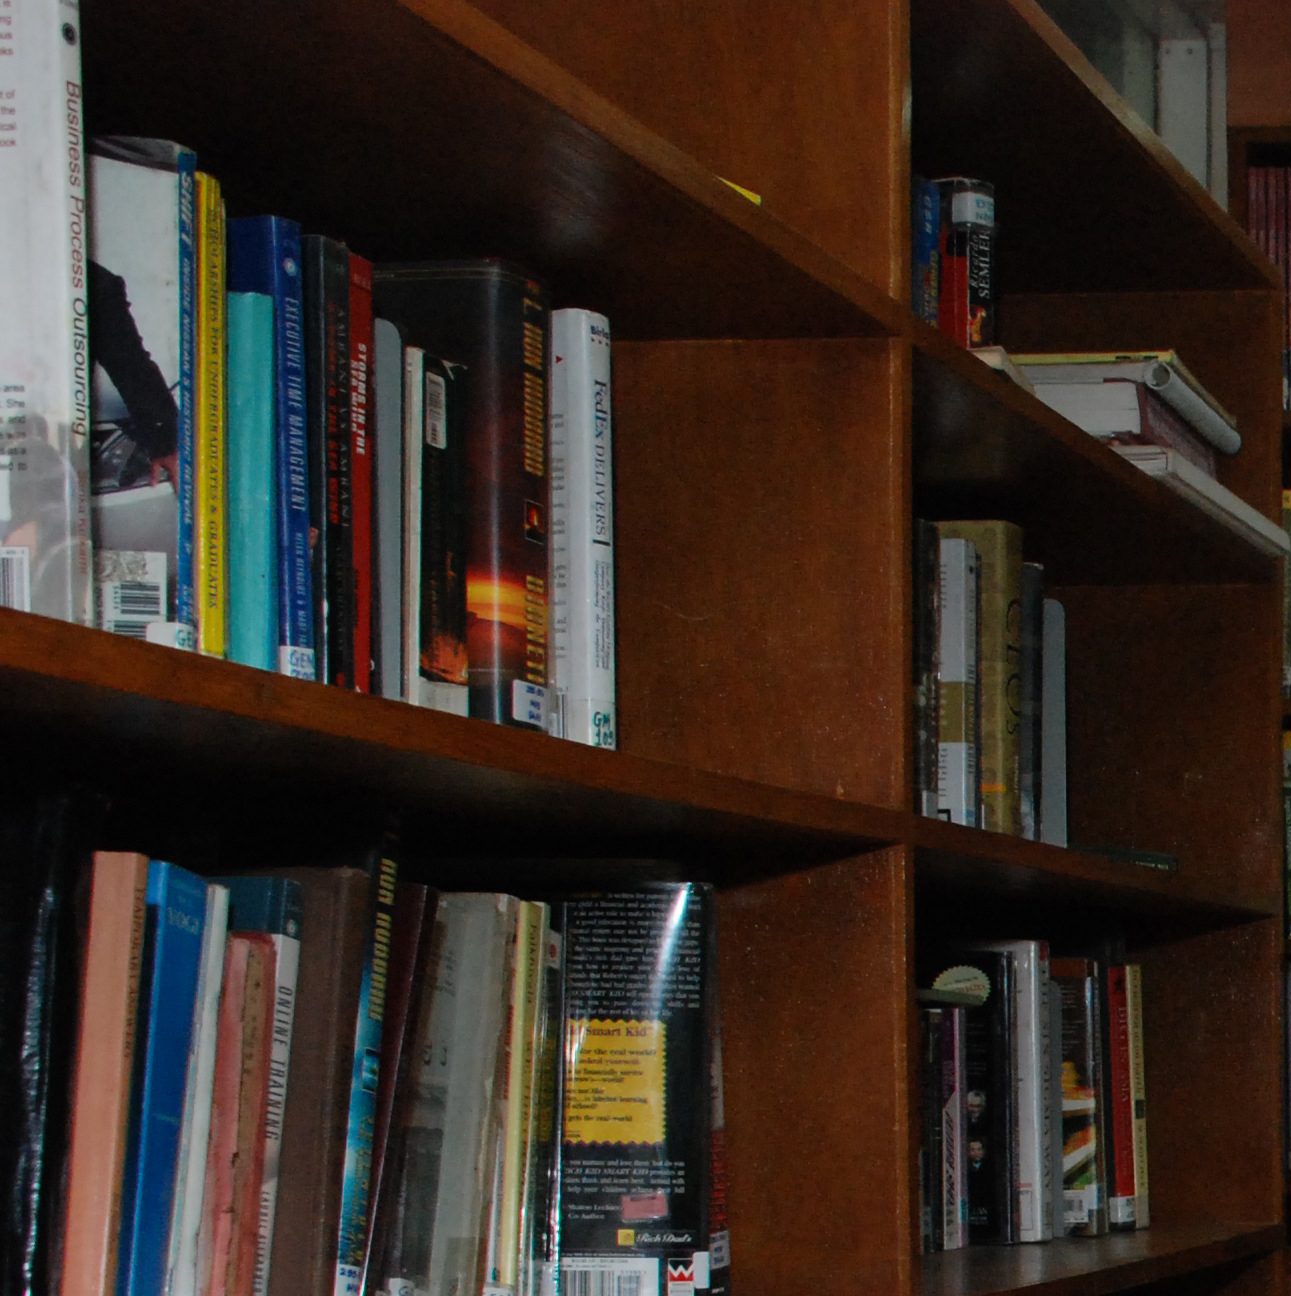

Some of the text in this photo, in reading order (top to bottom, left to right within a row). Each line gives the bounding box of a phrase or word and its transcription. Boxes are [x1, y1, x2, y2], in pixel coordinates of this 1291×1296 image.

[65, 80, 91, 437] Business Process Outsourcing
[978, 229, 991, 299] SEMLER
[283, 298, 306, 513] EXECUTIVE TIME MANAGEMENT
[592, 380, 607, 536] FedEx DELIVERS
[366, 912, 392, 1021] HUBBARD
[587, 1026, 648, 1038] Smart Kid
[264, 985, 294, 1141] ONLINE TRAINING
